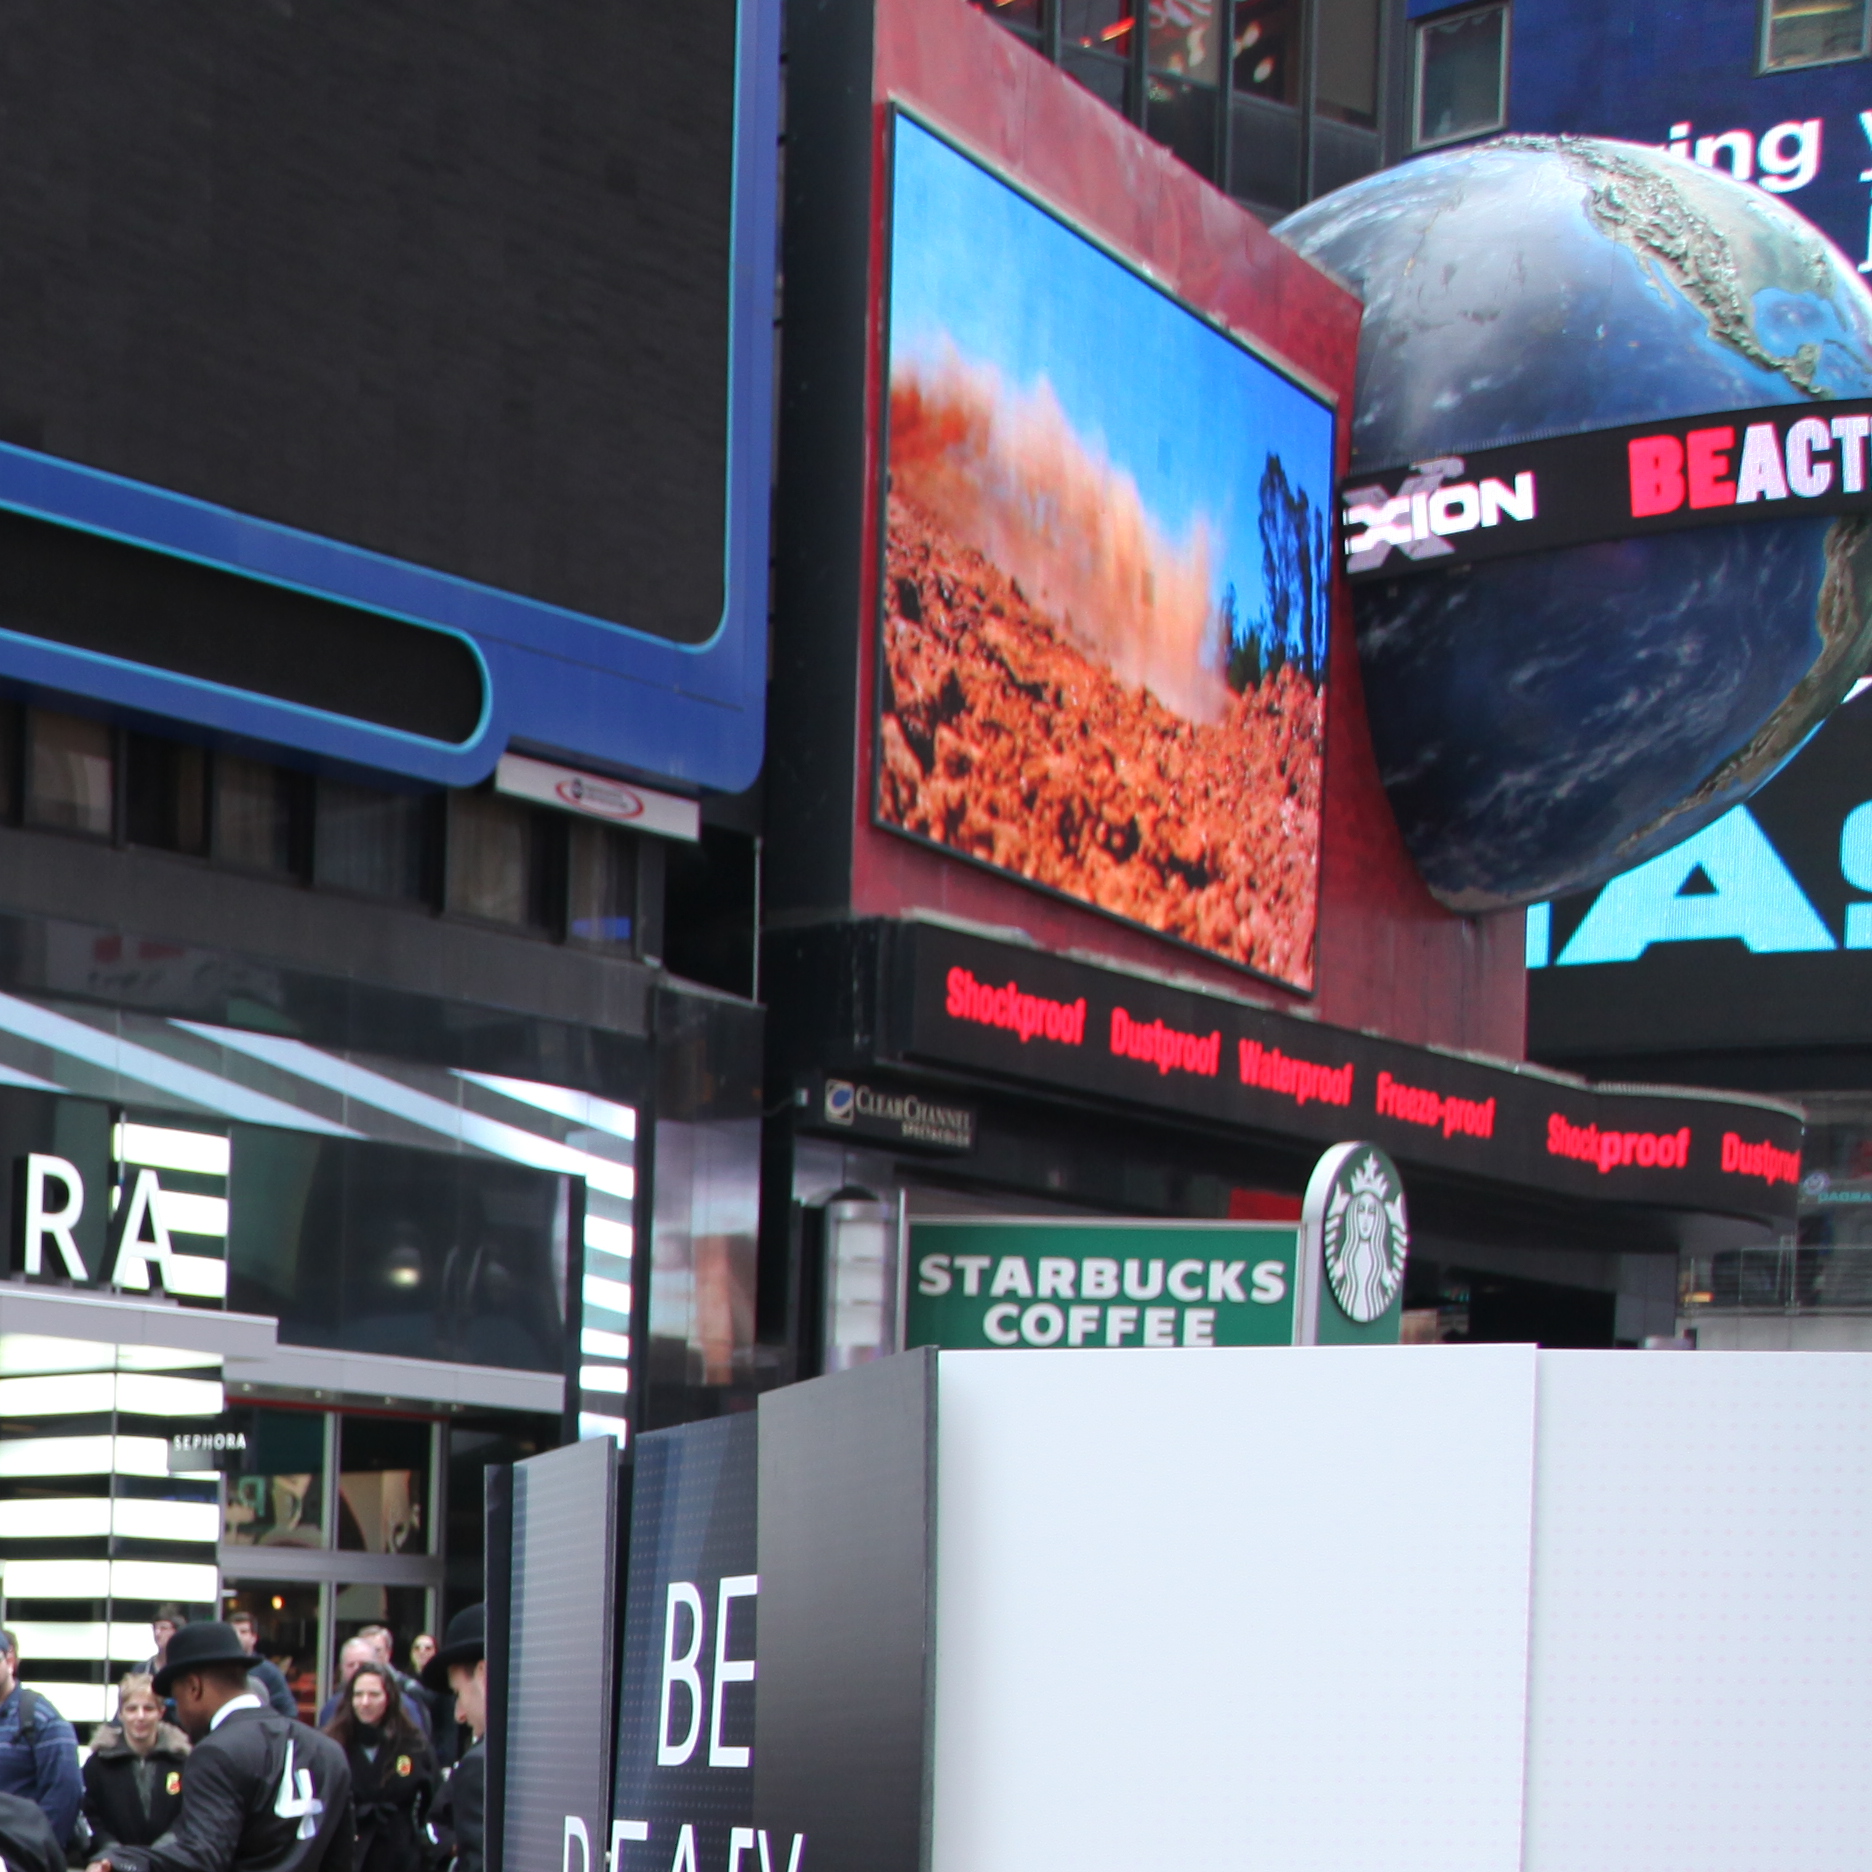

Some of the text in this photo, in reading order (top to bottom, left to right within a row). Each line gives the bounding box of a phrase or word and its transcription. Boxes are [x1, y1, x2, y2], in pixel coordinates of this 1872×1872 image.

[1660, 118, 1823, 193] ing
[1628, 415, 1872, 518] BEACT
[1342, 470, 1538, 556] XION
[946, 966, 1087, 1045] Shockproof
[1110, 1006, 1221, 1077] Dustproof
[1239, 1038, 1354, 1106] Waterproof
[1375, 1071, 1496, 1139] Freeze-proof
[1547, 1112, 1691, 1173] Shockproof
[917, 1252, 1287, 1305] STARBUCKS
[982, 1303, 1217, 1346] COFFEE
[172, 1432, 247, 1452] SEPHORA
[657, 1574, 759, 1768] BE
[272, 1738, 325, 1841] 4
